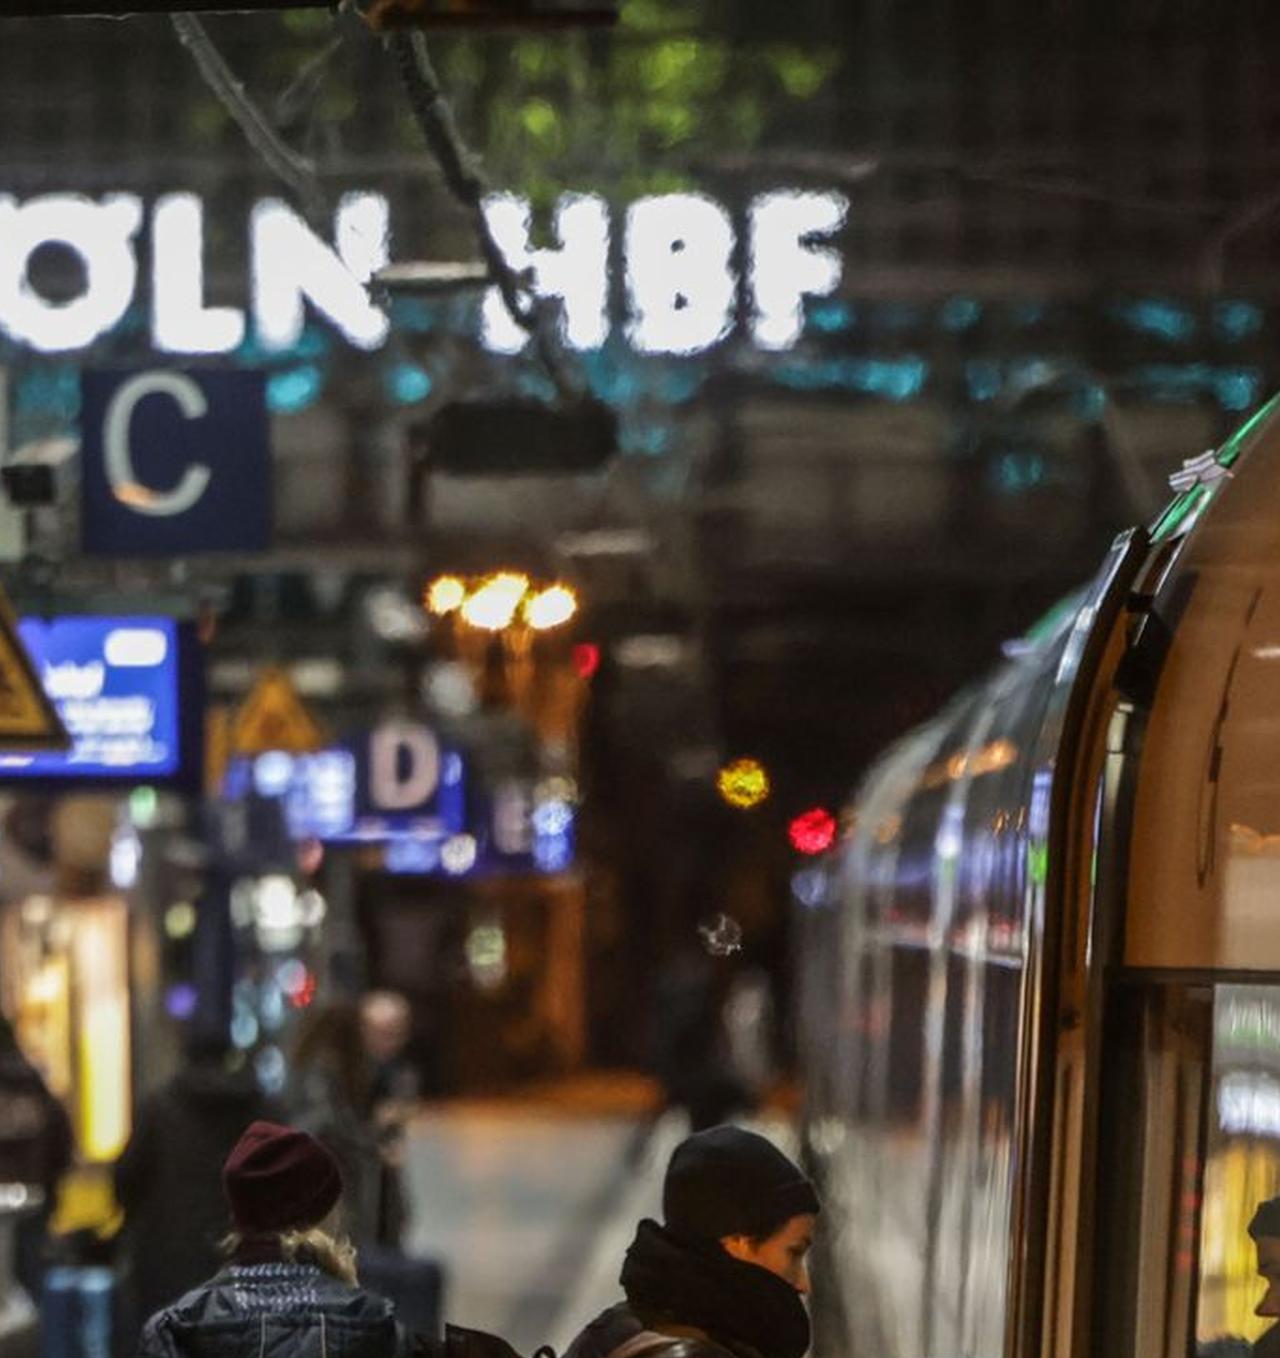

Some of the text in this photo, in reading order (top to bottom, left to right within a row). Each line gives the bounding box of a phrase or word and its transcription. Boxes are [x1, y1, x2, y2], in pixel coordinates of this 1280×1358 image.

[478, 188, 851, 354] HBF
[103, 370, 211, 516] C
[371, 722, 440, 810] D
